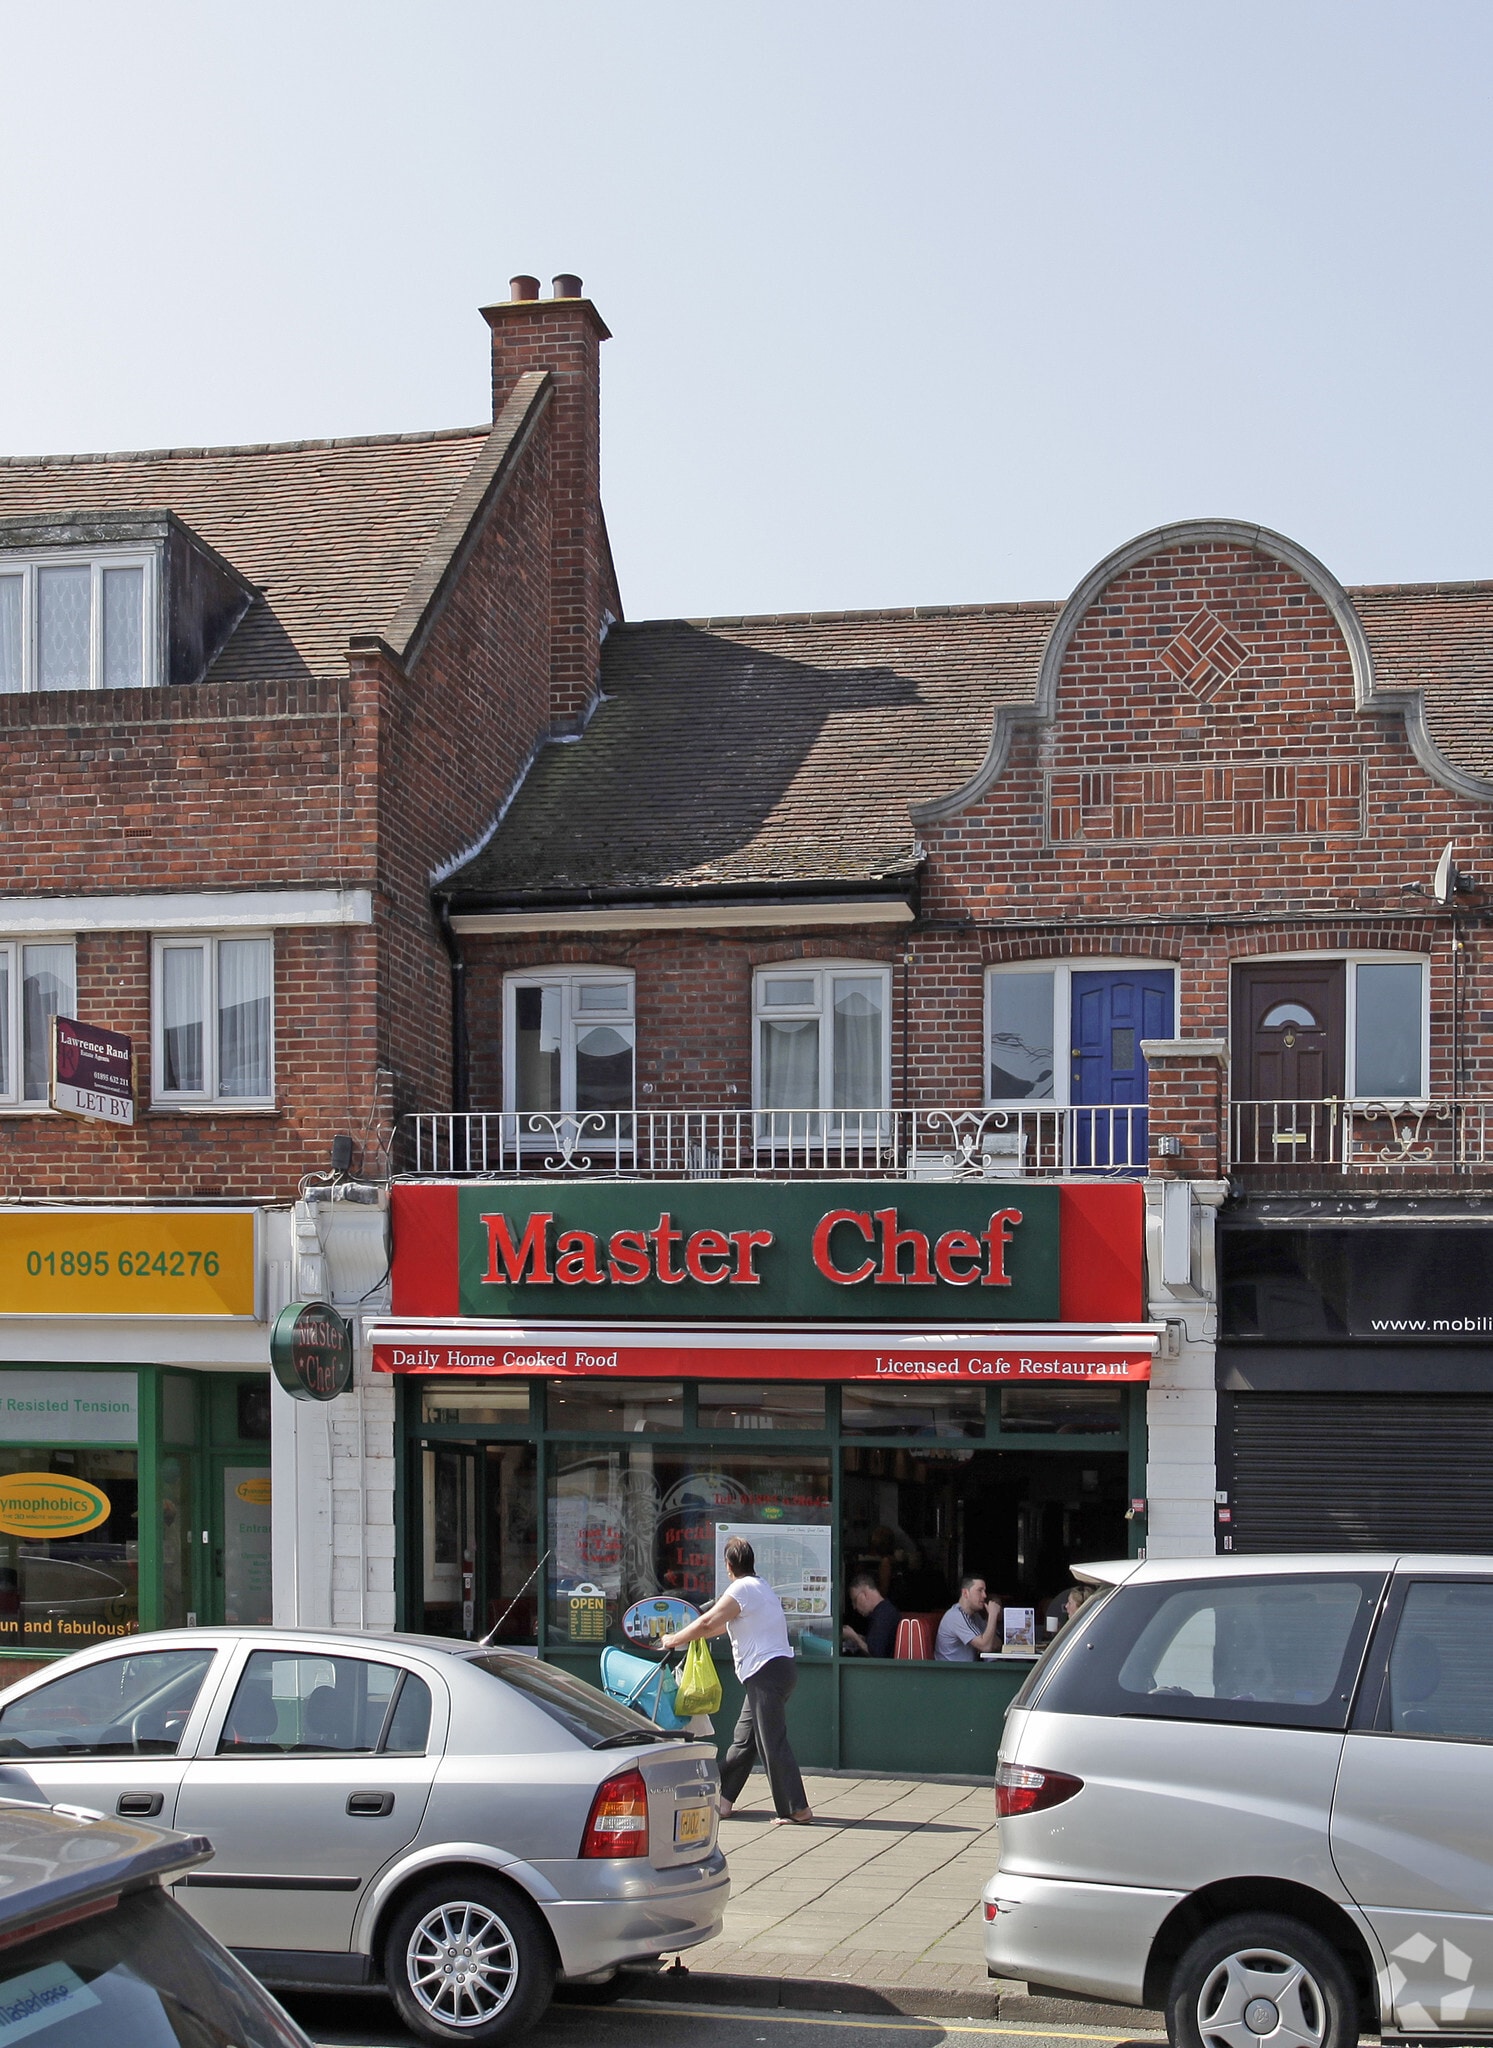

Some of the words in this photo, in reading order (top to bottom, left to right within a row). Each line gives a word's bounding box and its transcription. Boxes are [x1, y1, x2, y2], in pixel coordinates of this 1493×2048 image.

[60, 1031, 104, 1053] Lawrence
[106, 1044, 129, 1060] Rand
[76, 1090, 106, 1112] LET
[110, 1098, 130, 1118] BY
[479, 1211, 774, 1284] Master
[811, 1206, 1024, 1286] Chef
[26, 1250, 110, 1277] 01895
[117, 1250, 220, 1277] 624276
[299, 1316, 344, 1351] Master
[392, 1350, 440, 1369] Daily
[447, 1350, 496, 1367] Home
[502, 1351, 567, 1367] Cooked
[574, 1352, 618, 1368] Food
[875, 1357, 960, 1374] Licensed
[967, 1358, 1011, 1375] Cafe
[1018, 1358, 1129, 1375] Restaurant
[306, 1355, 337, 1392] Chef
[7, 1398, 69, 1413] Resisted
[73, 1399, 130, 1413] Tension
[570, 1597, 604, 1609] OPEN
[24, 1619, 52, 1633] and
